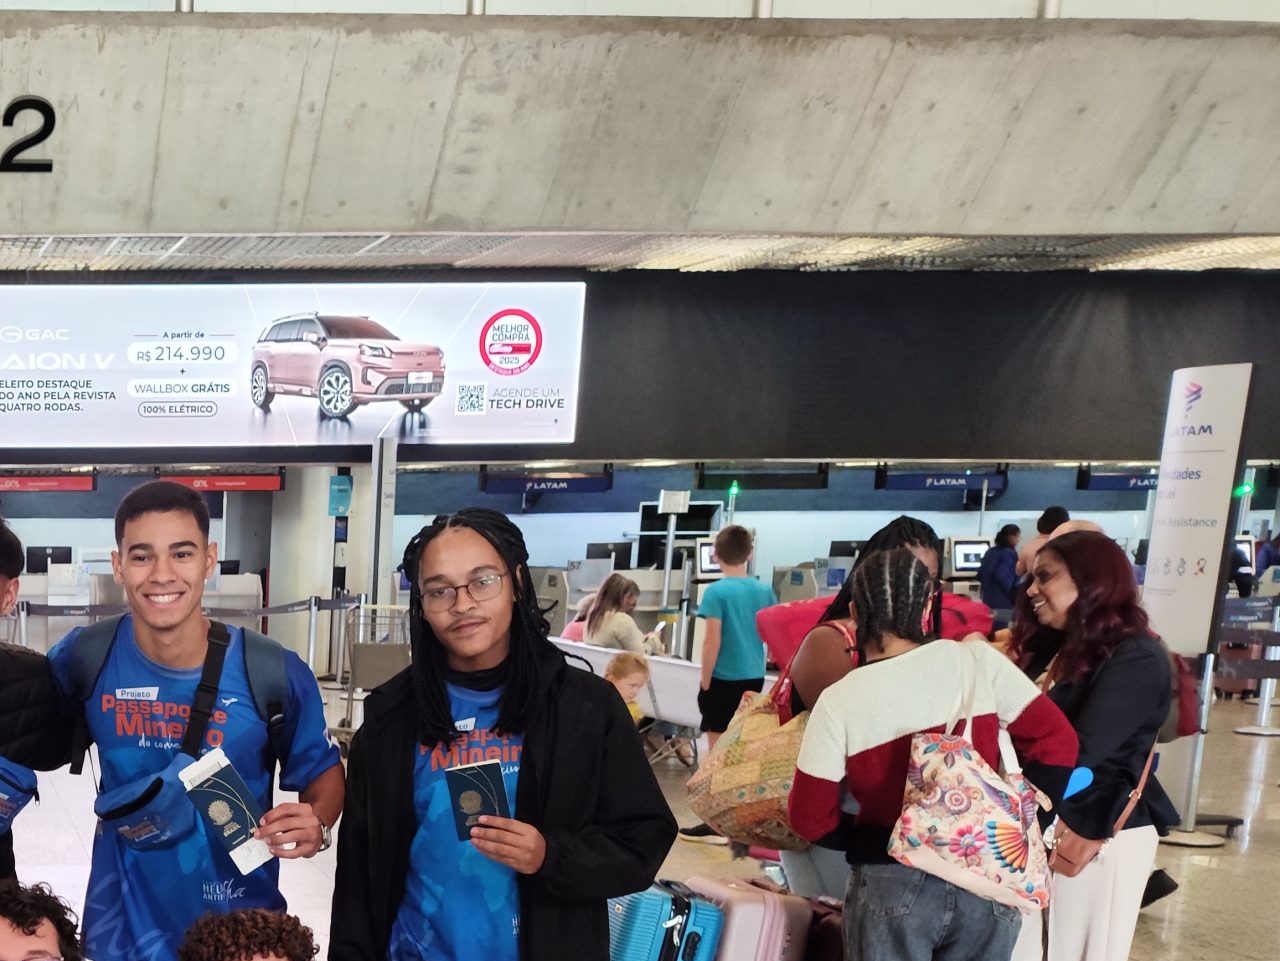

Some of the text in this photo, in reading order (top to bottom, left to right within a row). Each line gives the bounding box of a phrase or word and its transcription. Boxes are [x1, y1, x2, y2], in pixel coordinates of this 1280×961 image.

[0, 95, 56, 173] 2
[492, 324, 529, 333] MELHOR
[24, 328, 70, 340] GAC
[171, 331, 192, 339] partir
[492, 333, 530, 342] COMPRA
[137, 346, 225, 362] R$ 214.990
[0, 352, 116, 370] AION V
[499, 356, 520, 364] 2025
[37, 380, 92, 389] DESTAQUE
[135, 382, 230, 393] WALLBOX GRÁTIS
[492, 387, 560, 398] AGENDE UM
[44, 403, 84, 411] RODAS.
[489, 398, 565, 409] TECH DRIVE
[143, 404, 213, 414] 100% ELÉTRICO
[933, 478, 966, 486] LATAM
[120, 689, 151, 699] Projeto
